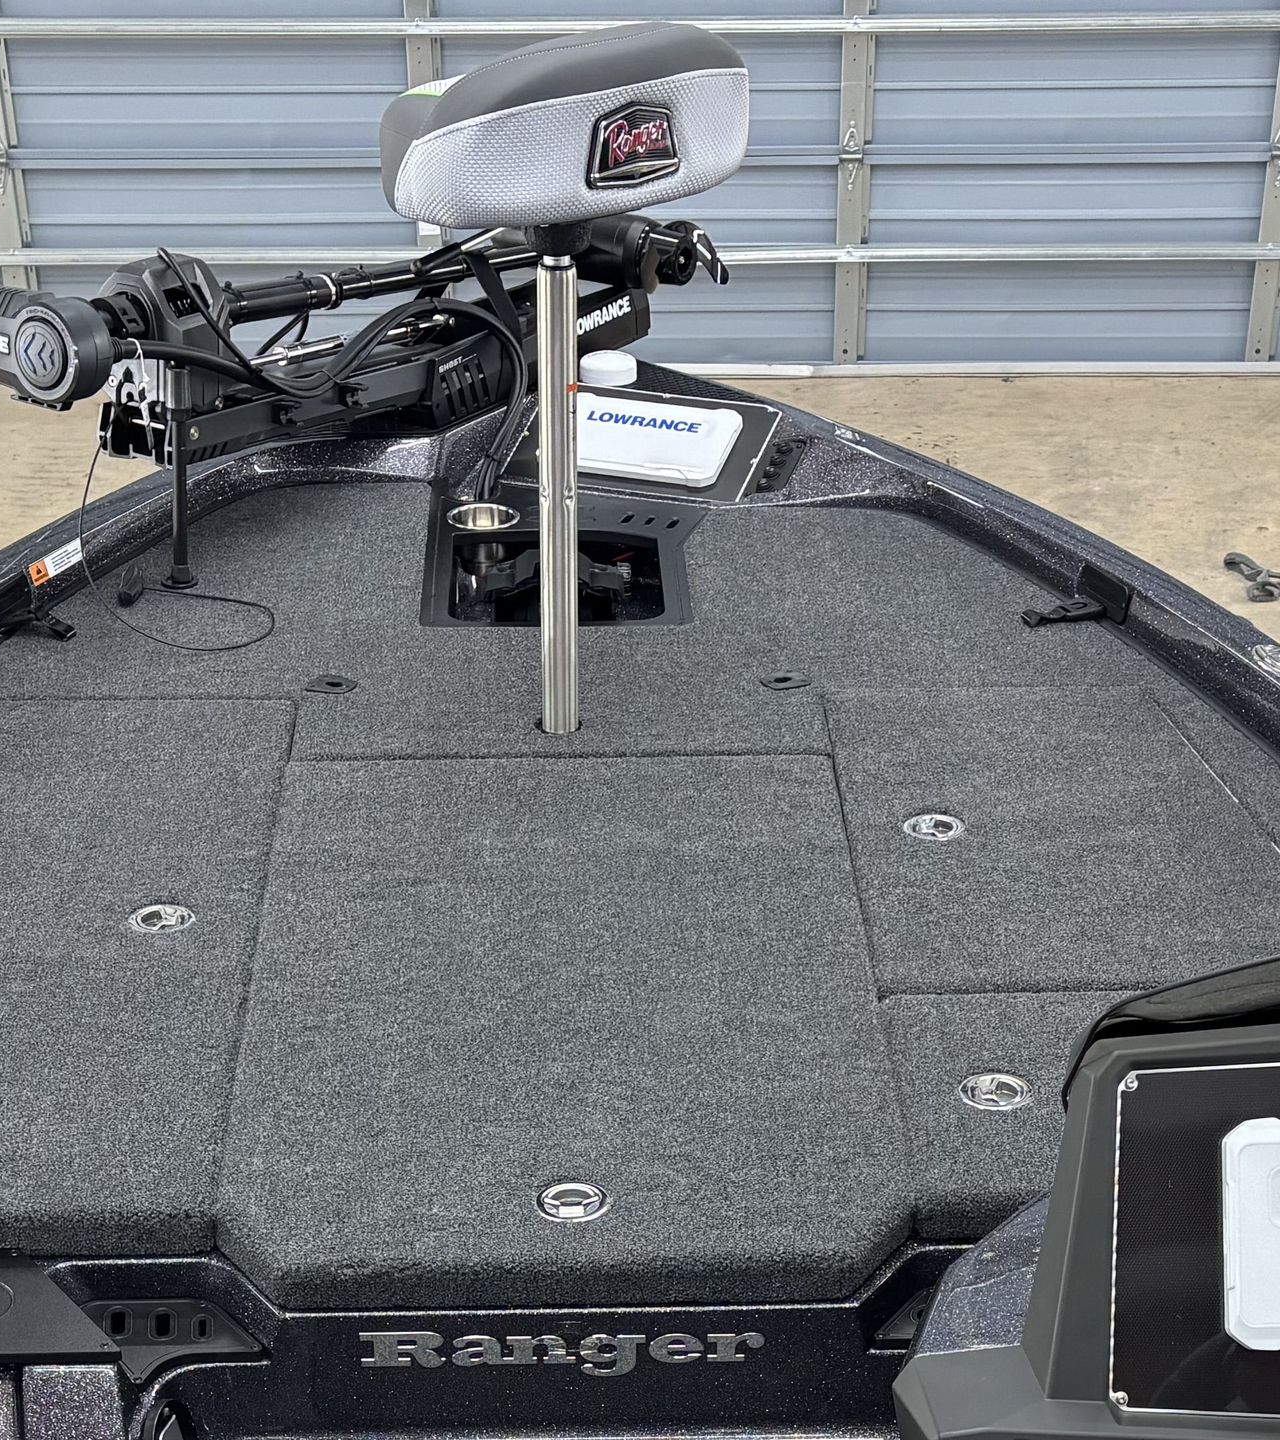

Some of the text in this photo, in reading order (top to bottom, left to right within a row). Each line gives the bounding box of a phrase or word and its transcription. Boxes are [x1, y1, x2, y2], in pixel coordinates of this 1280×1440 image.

[576, 296, 631, 335] OWRANCE
[439, 356, 463, 373] GHOST
[587, 410, 701, 433] LOWRANCE
[358, 1331, 766, 1377] Ranger
